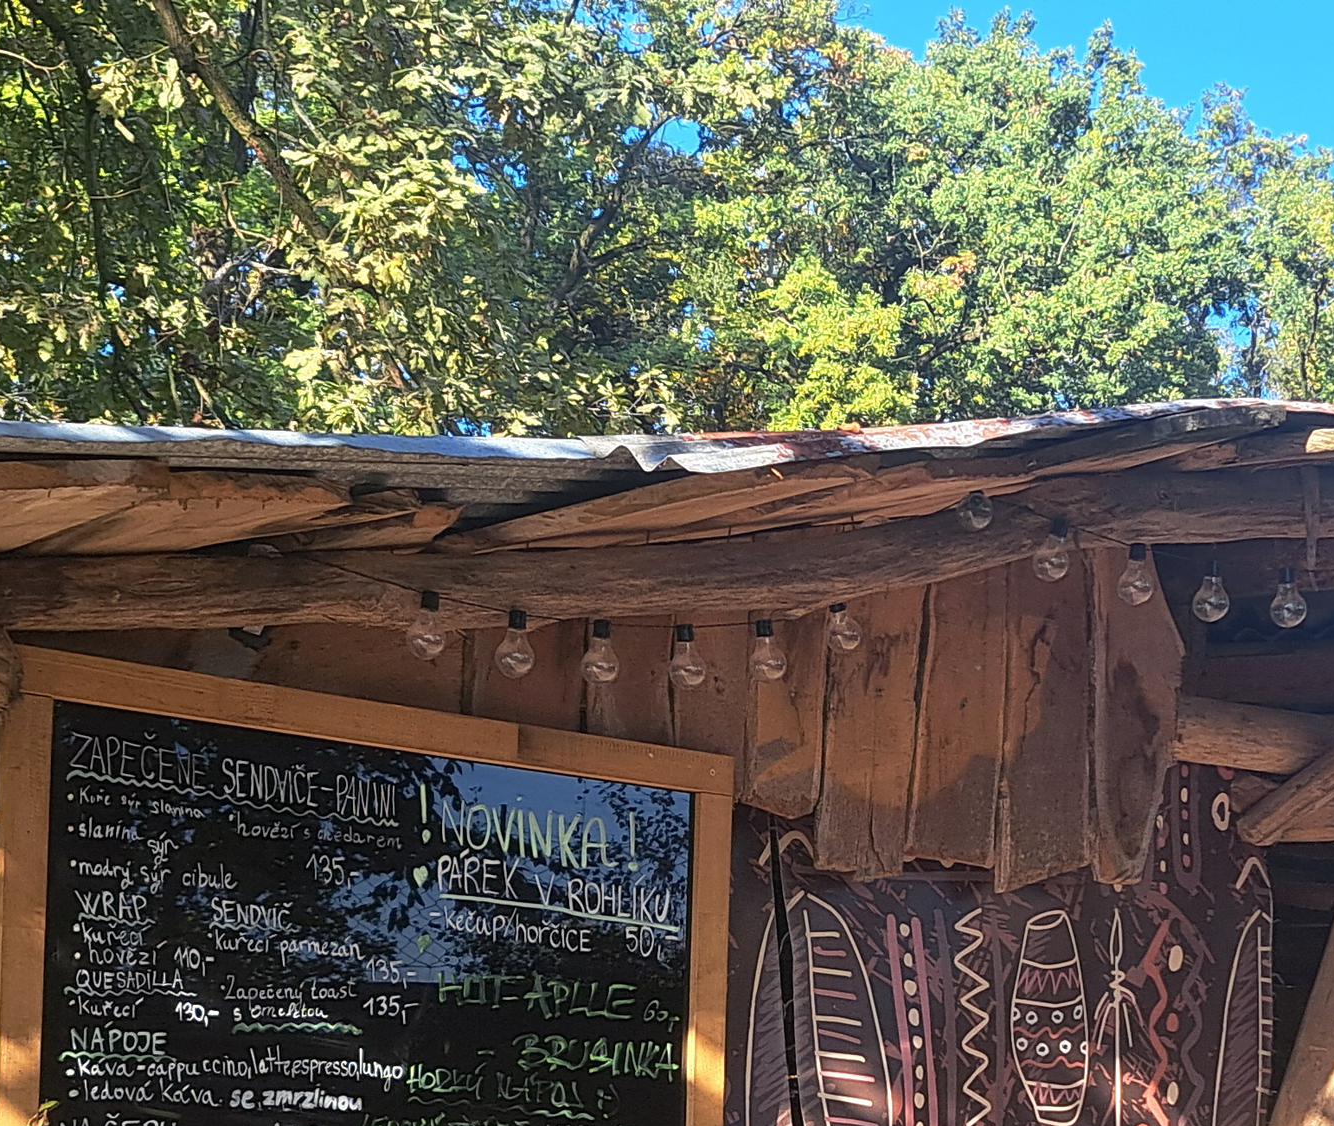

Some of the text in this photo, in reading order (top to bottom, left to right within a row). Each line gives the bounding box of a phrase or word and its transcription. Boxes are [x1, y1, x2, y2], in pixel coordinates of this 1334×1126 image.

[182, 862, 238, 890] cibule
[437, 848, 520, 900] PÁREK
[567, 874, 671, 924] ROHLÍKU
[74, 889, 147, 921] WRAP
[310, 977, 357, 1000] toast
[70, 1020, 168, 1056] NÁPOJE
